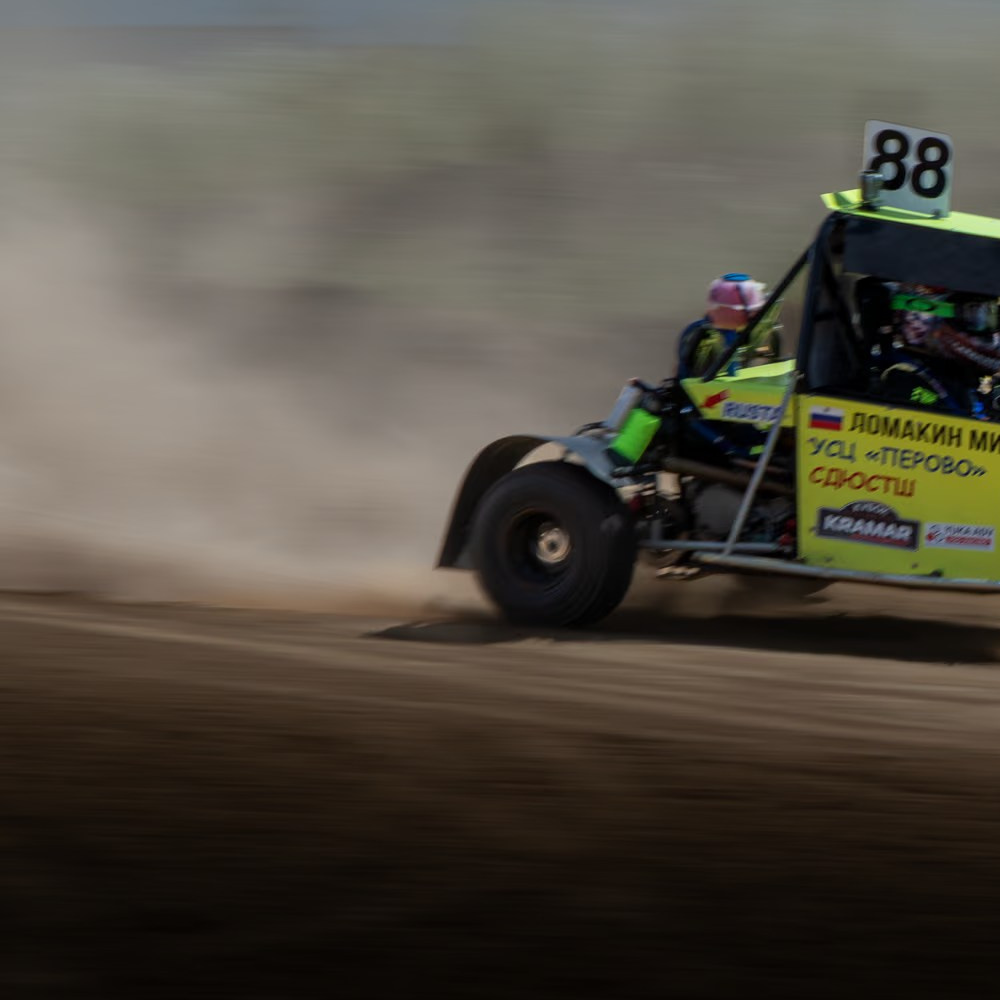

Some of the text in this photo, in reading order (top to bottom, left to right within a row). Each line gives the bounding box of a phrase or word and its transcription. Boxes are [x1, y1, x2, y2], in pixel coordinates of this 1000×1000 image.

[870, 128, 950, 199] 88
[848, 412, 962, 449] ЛОМАКИН
[807, 436, 857, 463] УСЦ
[808, 466, 917, 498] СДЮСТШ
